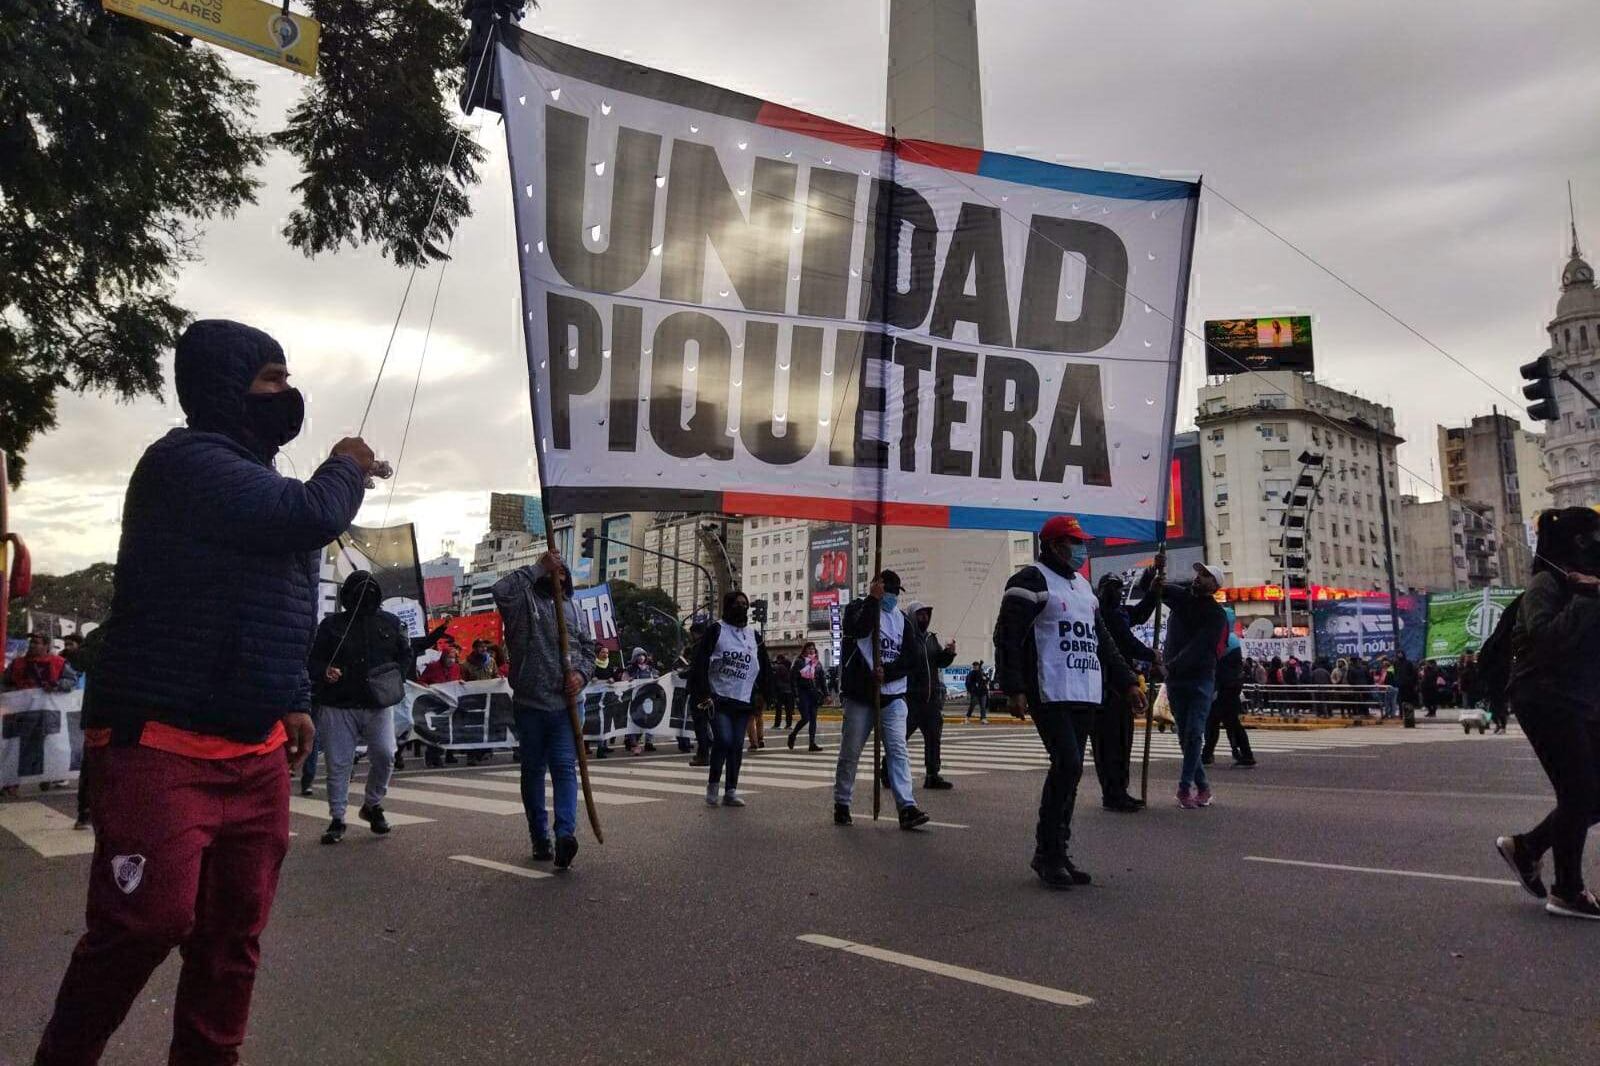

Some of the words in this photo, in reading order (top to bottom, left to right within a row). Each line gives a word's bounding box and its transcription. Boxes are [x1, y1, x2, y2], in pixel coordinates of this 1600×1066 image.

[545, 104, 1129, 354] UNIDAD
[545, 291, 1113, 488] PIQUETERA
[1066, 652, 1100, 674] Capita
